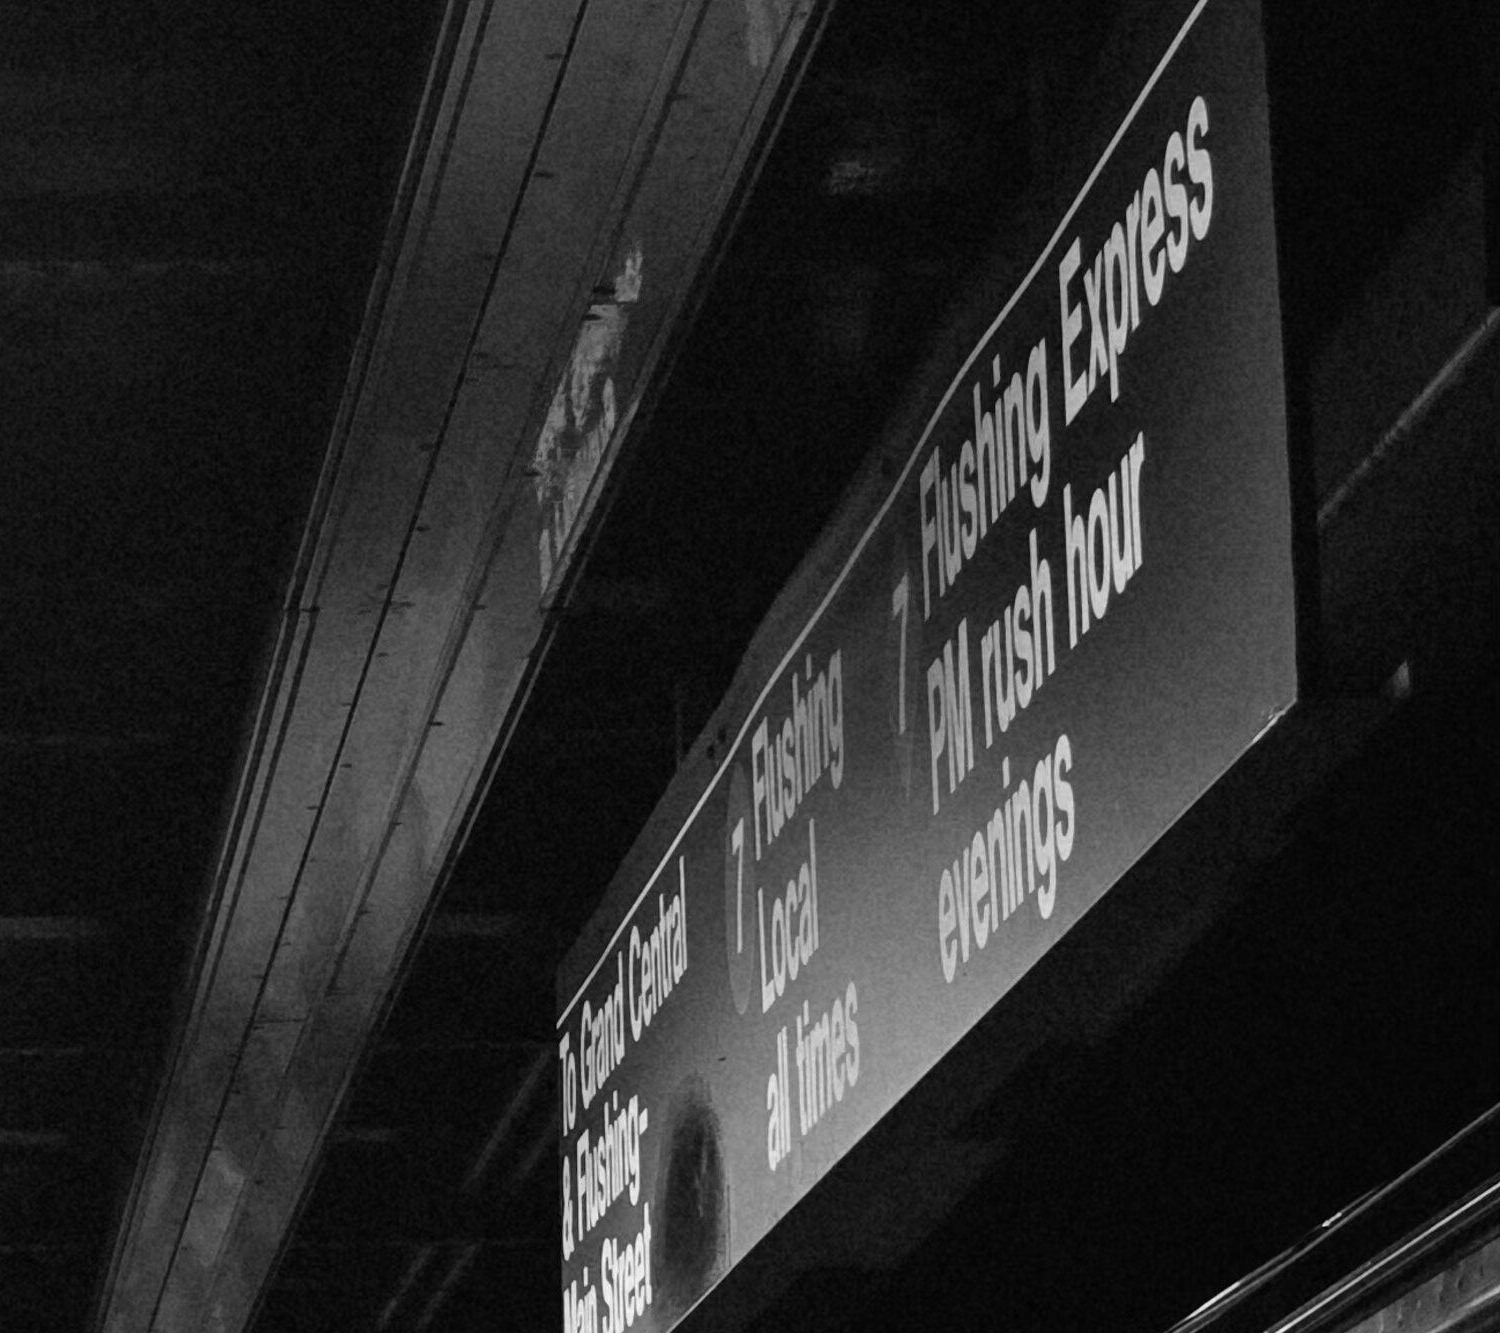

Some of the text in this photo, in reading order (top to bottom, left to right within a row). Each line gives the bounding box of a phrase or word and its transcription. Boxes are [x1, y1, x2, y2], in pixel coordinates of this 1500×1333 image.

[919, 95, 1213, 621] Flushing Express
[927, 430, 1146, 816] PM rush hour
[752, 648, 844, 861] Flushing
[938, 733, 1075, 984] evenings
[558, 855, 688, 1137] To Grand Central
[757, 817, 820, 1014] Local
[562, 1089, 649, 1262] & Flushing-
[766, 980, 861, 1172] all times
